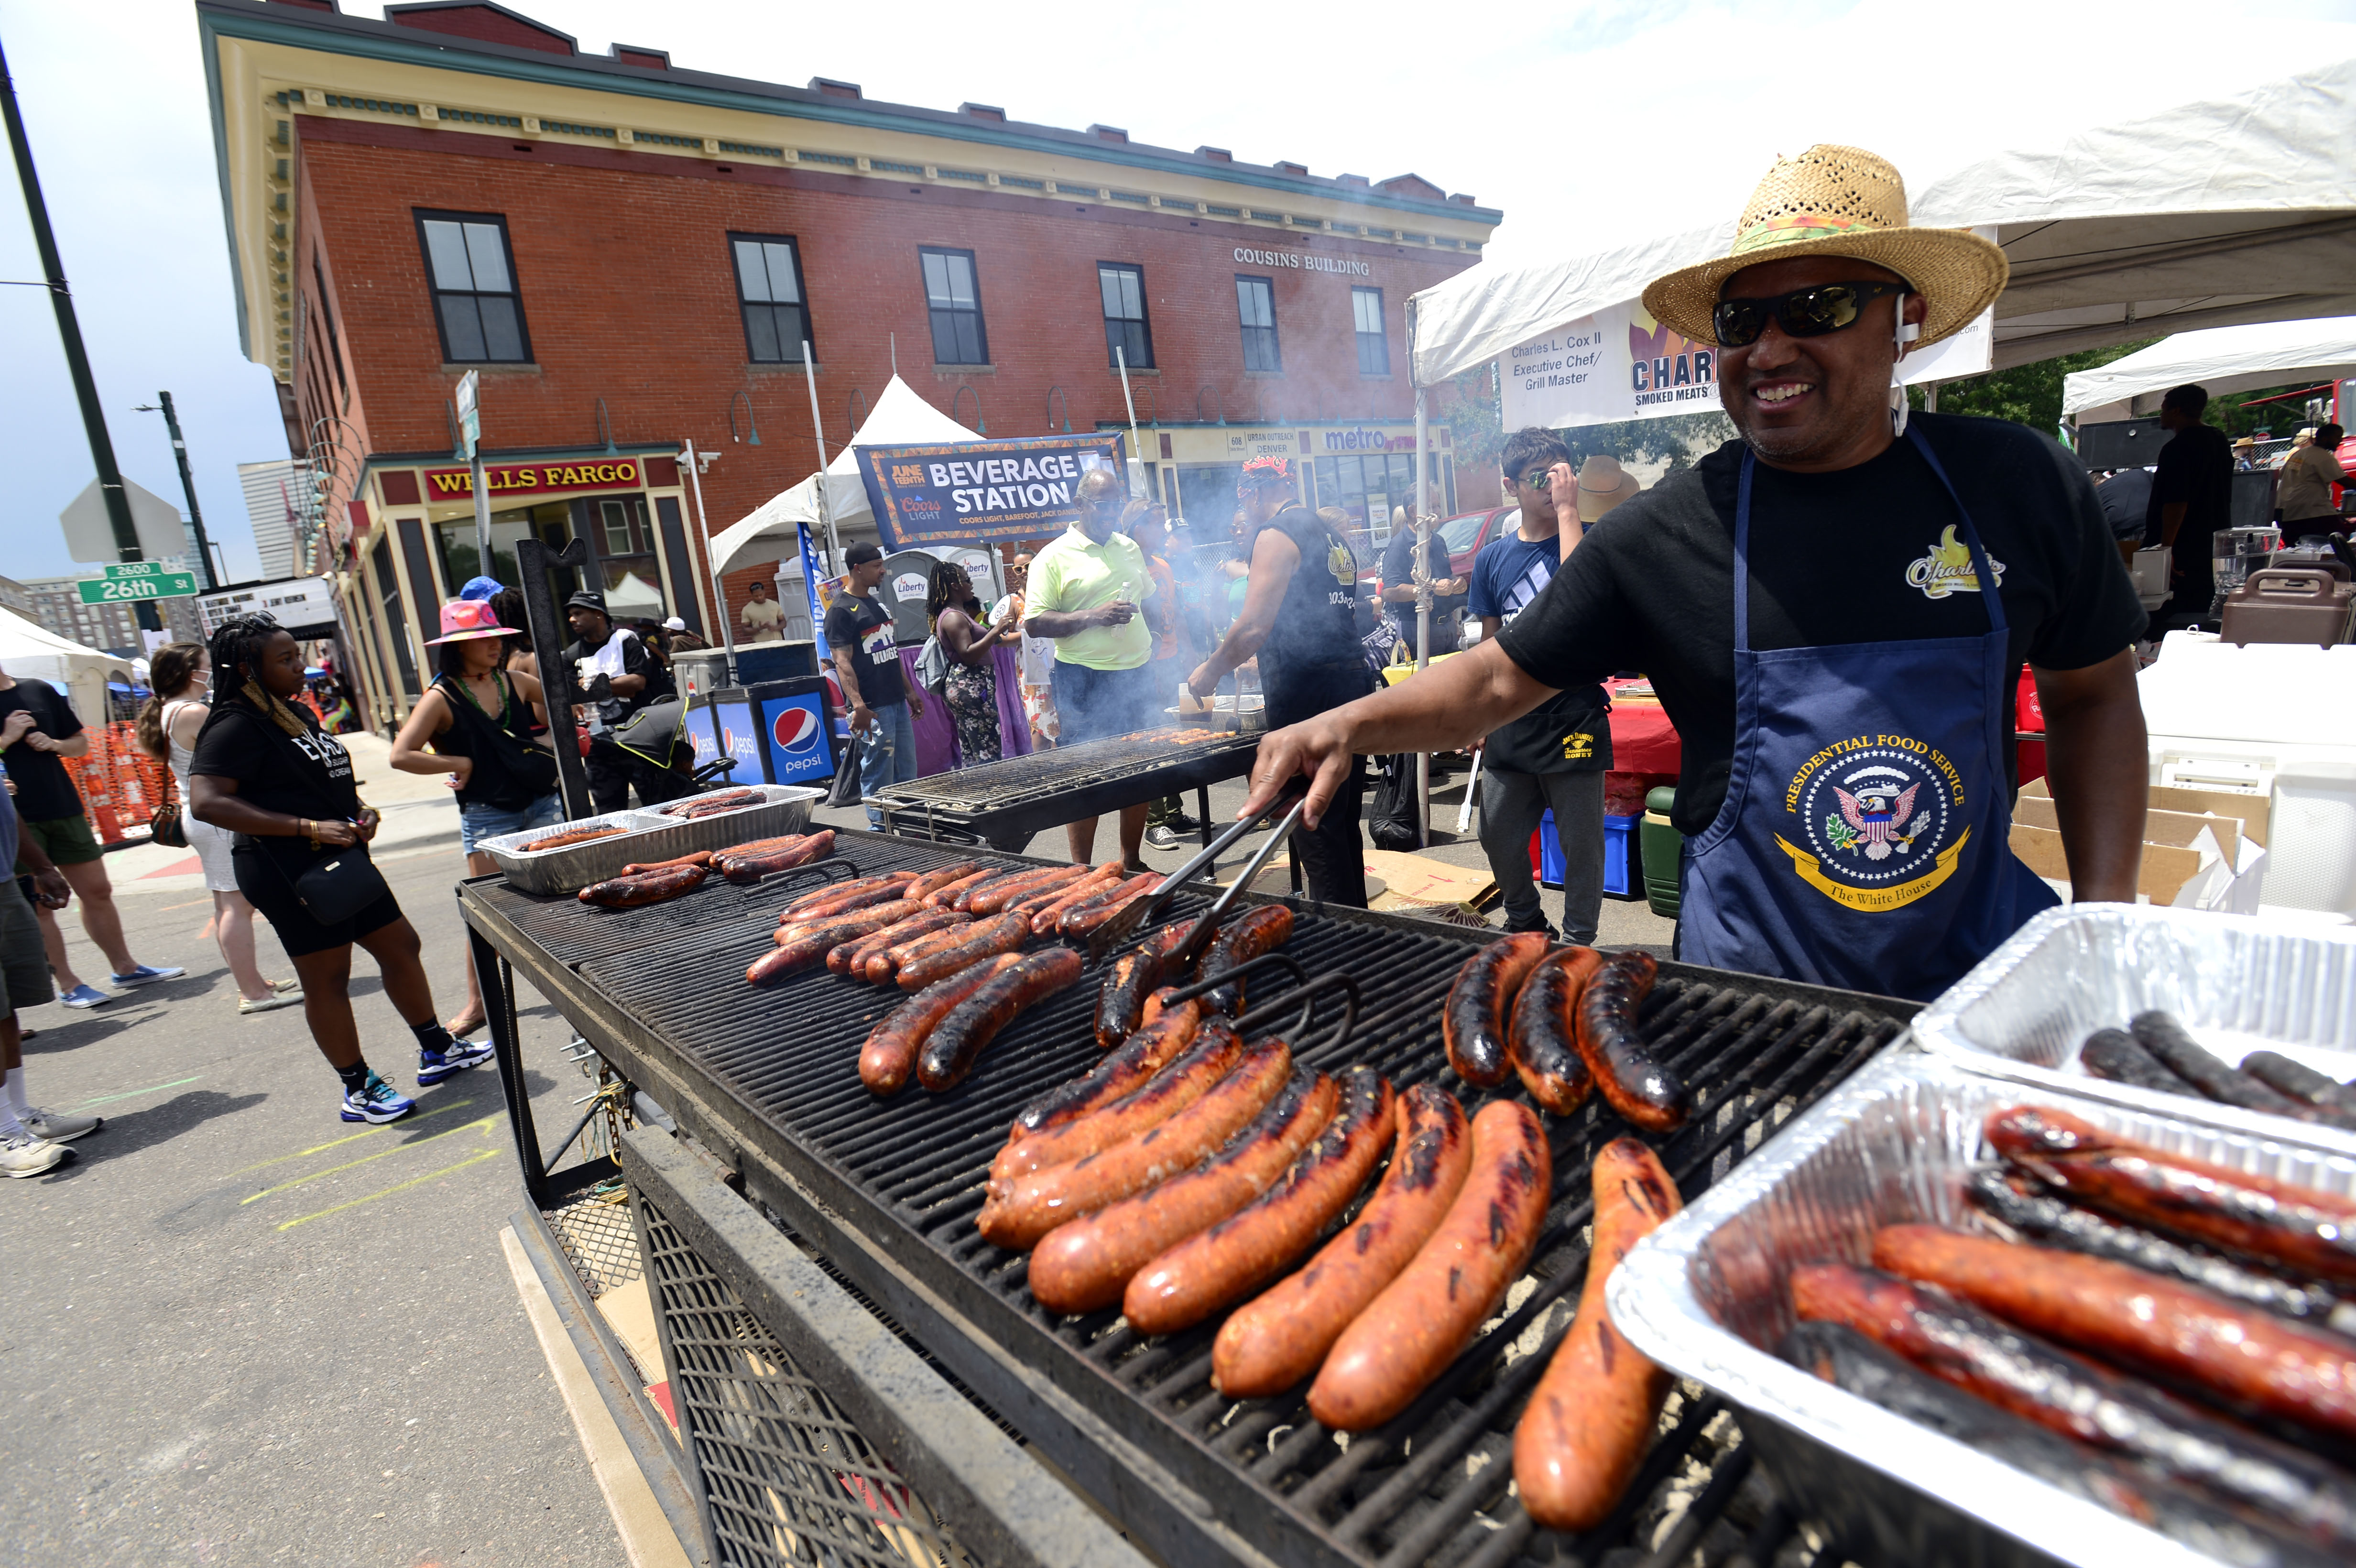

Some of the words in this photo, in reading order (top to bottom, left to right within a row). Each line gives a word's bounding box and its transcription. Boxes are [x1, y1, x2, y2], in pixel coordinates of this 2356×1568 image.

[1233, 248, 1298, 268] COUSINS
[1304, 256, 1369, 276] BUILDING
[1957, 325, 1978, 335] .com
[1512, 343, 1548, 358] Charles
[1552, 339, 1562, 351] L.
[1567, 337, 1590, 348] Cox
[1594, 332, 1601, 344] II
[1514, 360, 1562, 376] Executive
[1567, 351, 1602, 367] Chef/
[1631, 349, 1719, 393] CHAR
[1526, 377, 1545, 390] Grill
[1549, 373, 1588, 387] Master
[1636, 391, 1673, 405] SMOKED
[1676, 387, 1708, 401] MEATS
[1232, 436, 1242, 445] 608
[1247, 433, 1266, 441] URBAN
[1267, 432, 1294, 441] OUTREACH
[1326, 426, 1385, 450] metro
[1257, 445, 1288, 453] DENVER
[543, 463, 636, 486] FARGO
[892, 464, 923, 477] JUNE
[929, 455, 1078, 487] BEVERAGE
[892, 475, 926, 485] TEENTH
[900, 497, 941, 512] Coors
[952, 481, 1071, 513] STATION
[909, 511, 940, 521] LIGHT
[959, 516, 983, 524] COORS
[984, 514, 1004, 523] LIGHT,
[1005, 512, 1040, 521] BAREFOOT,
[116, 565, 151, 576] 2600
[962, 564, 989, 573] iberty
[100, 579, 158, 599] 26th
[174, 579, 188, 589] St
[898, 582, 925, 592] Liberty
[699, 733, 716, 757] pepsi
[735, 734, 756, 758] pepsi
[1562, 735, 1575, 745] JACK
[785, 754, 821, 773] pepsi
[1786, 736, 1873, 813] PRESIDENTIAL
[1877, 735, 1928, 754] FOOD
[1929, 749, 1964, 806] SERVICE
[1831, 885, 1853, 902] The
[1857, 893, 1893, 904] White
[1896, 880, 1931, 901] House
